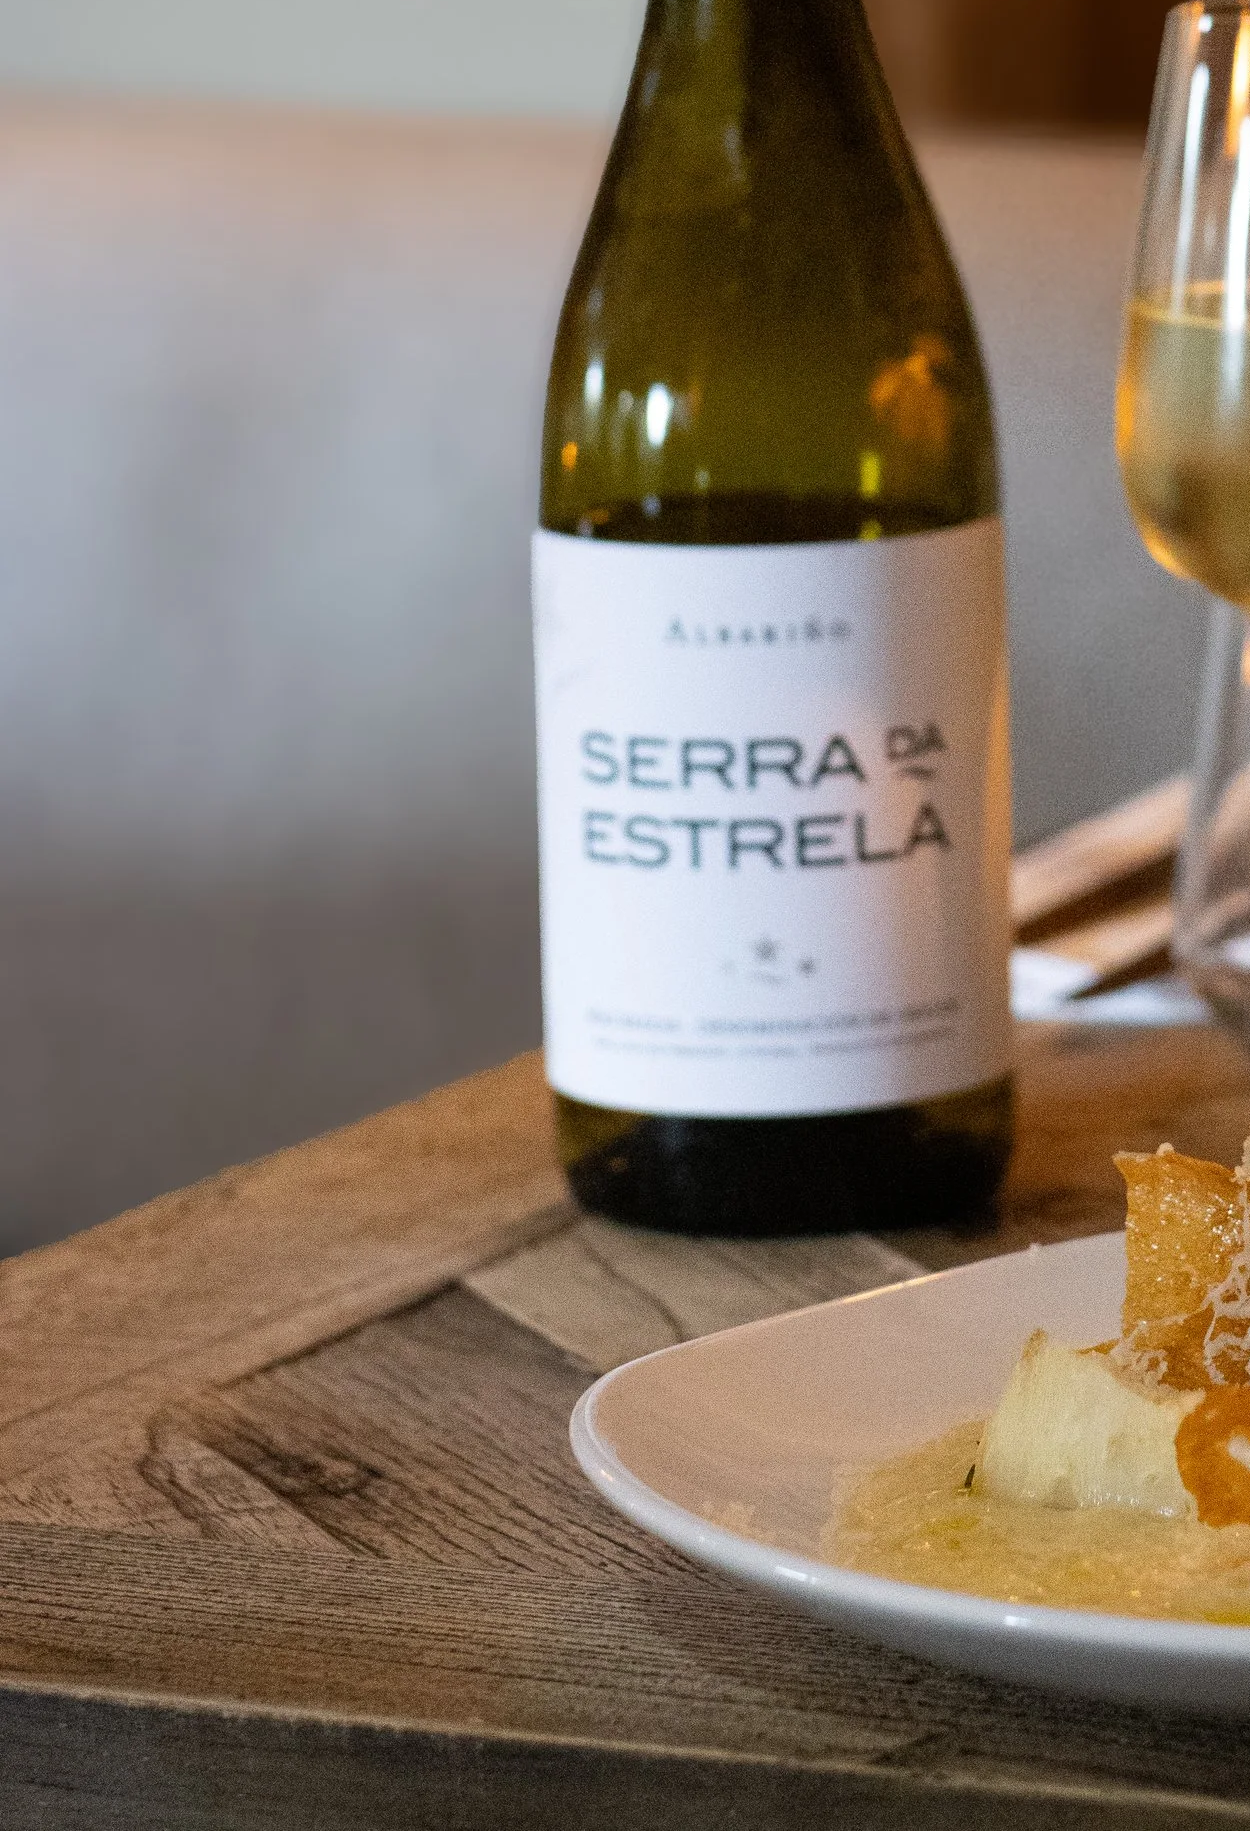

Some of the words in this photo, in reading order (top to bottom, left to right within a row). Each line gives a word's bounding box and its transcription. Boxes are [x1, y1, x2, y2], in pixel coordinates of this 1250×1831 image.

[581, 730, 866, 789] SERRA
[884, 723, 947, 763] DA
[582, 802, 951, 869] ESTRELA
